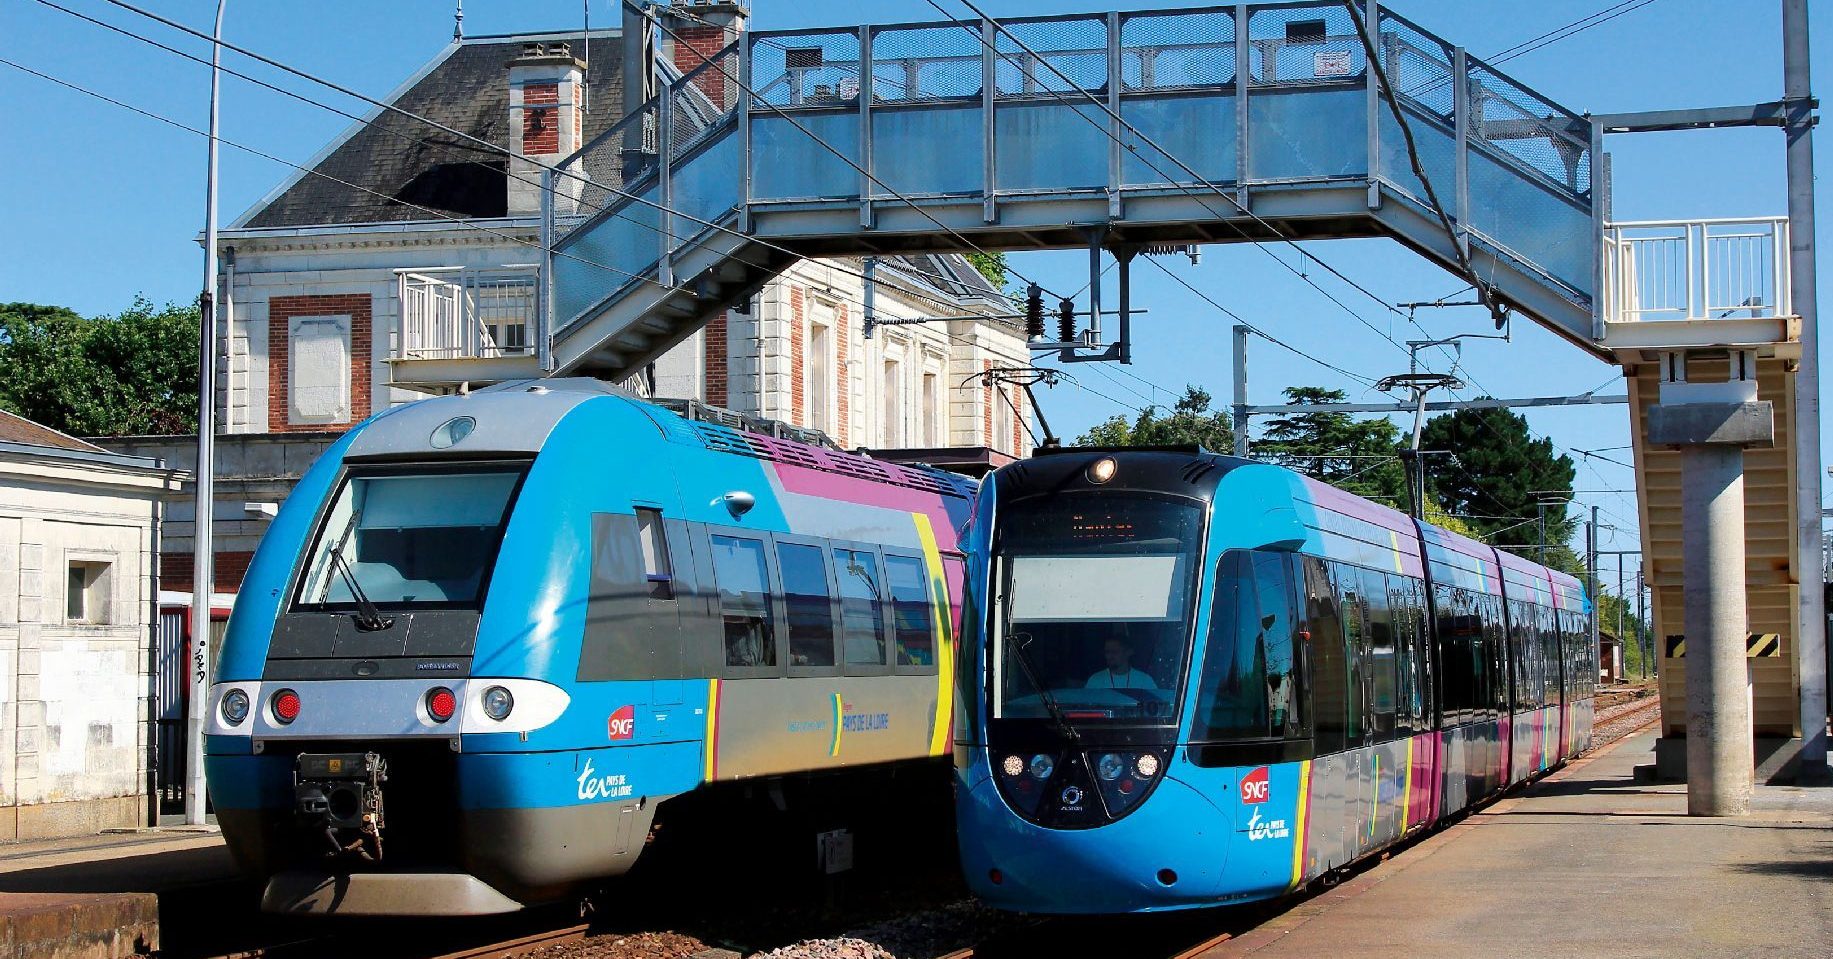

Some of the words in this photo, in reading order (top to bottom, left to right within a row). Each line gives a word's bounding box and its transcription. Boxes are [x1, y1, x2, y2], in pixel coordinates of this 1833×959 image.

[610, 718, 634, 735] SNCF
[843, 714, 856, 732] PAYS
[857, 714, 865, 731] DE
[866, 714, 873, 730] LA
[874, 713, 888, 729] LOIRE
[577, 757, 610, 800] ter
[606, 775, 618, 786] PAYS
[619, 774, 626, 785] DE
[1243, 780, 1269, 800] SNCF
[1247, 806, 1274, 841] ter
